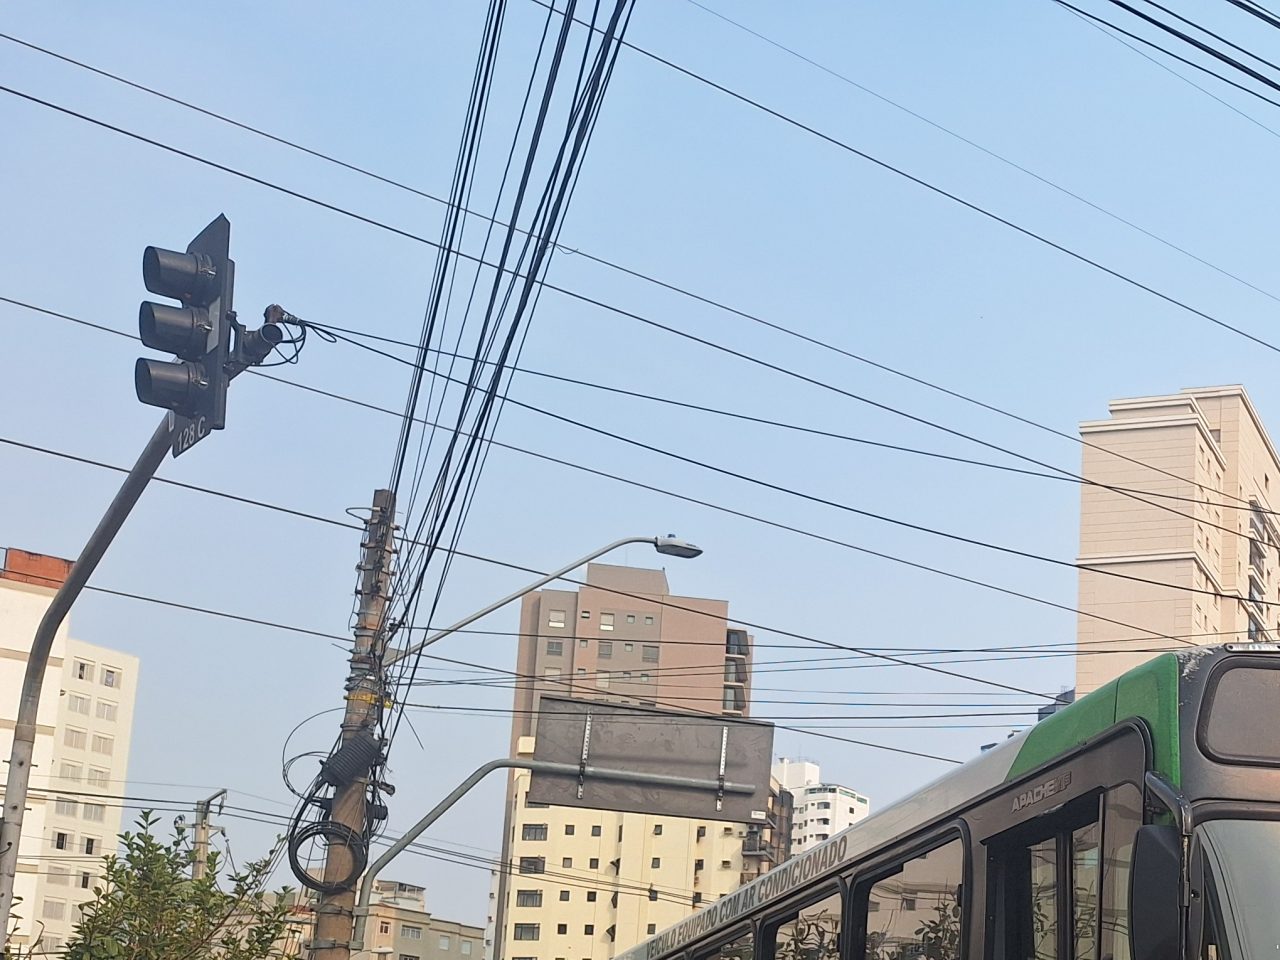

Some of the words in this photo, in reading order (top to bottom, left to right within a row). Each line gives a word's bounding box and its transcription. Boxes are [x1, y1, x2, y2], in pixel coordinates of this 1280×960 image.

[178, 423, 195, 452] 128
[197, 415, 206, 438] C
[677, 906, 718, 946] EQUIPADO
[719, 895, 740, 921] COM
[741, 887, 756, 912] AR
[758, 835, 848, 902] CONDICIONADO
